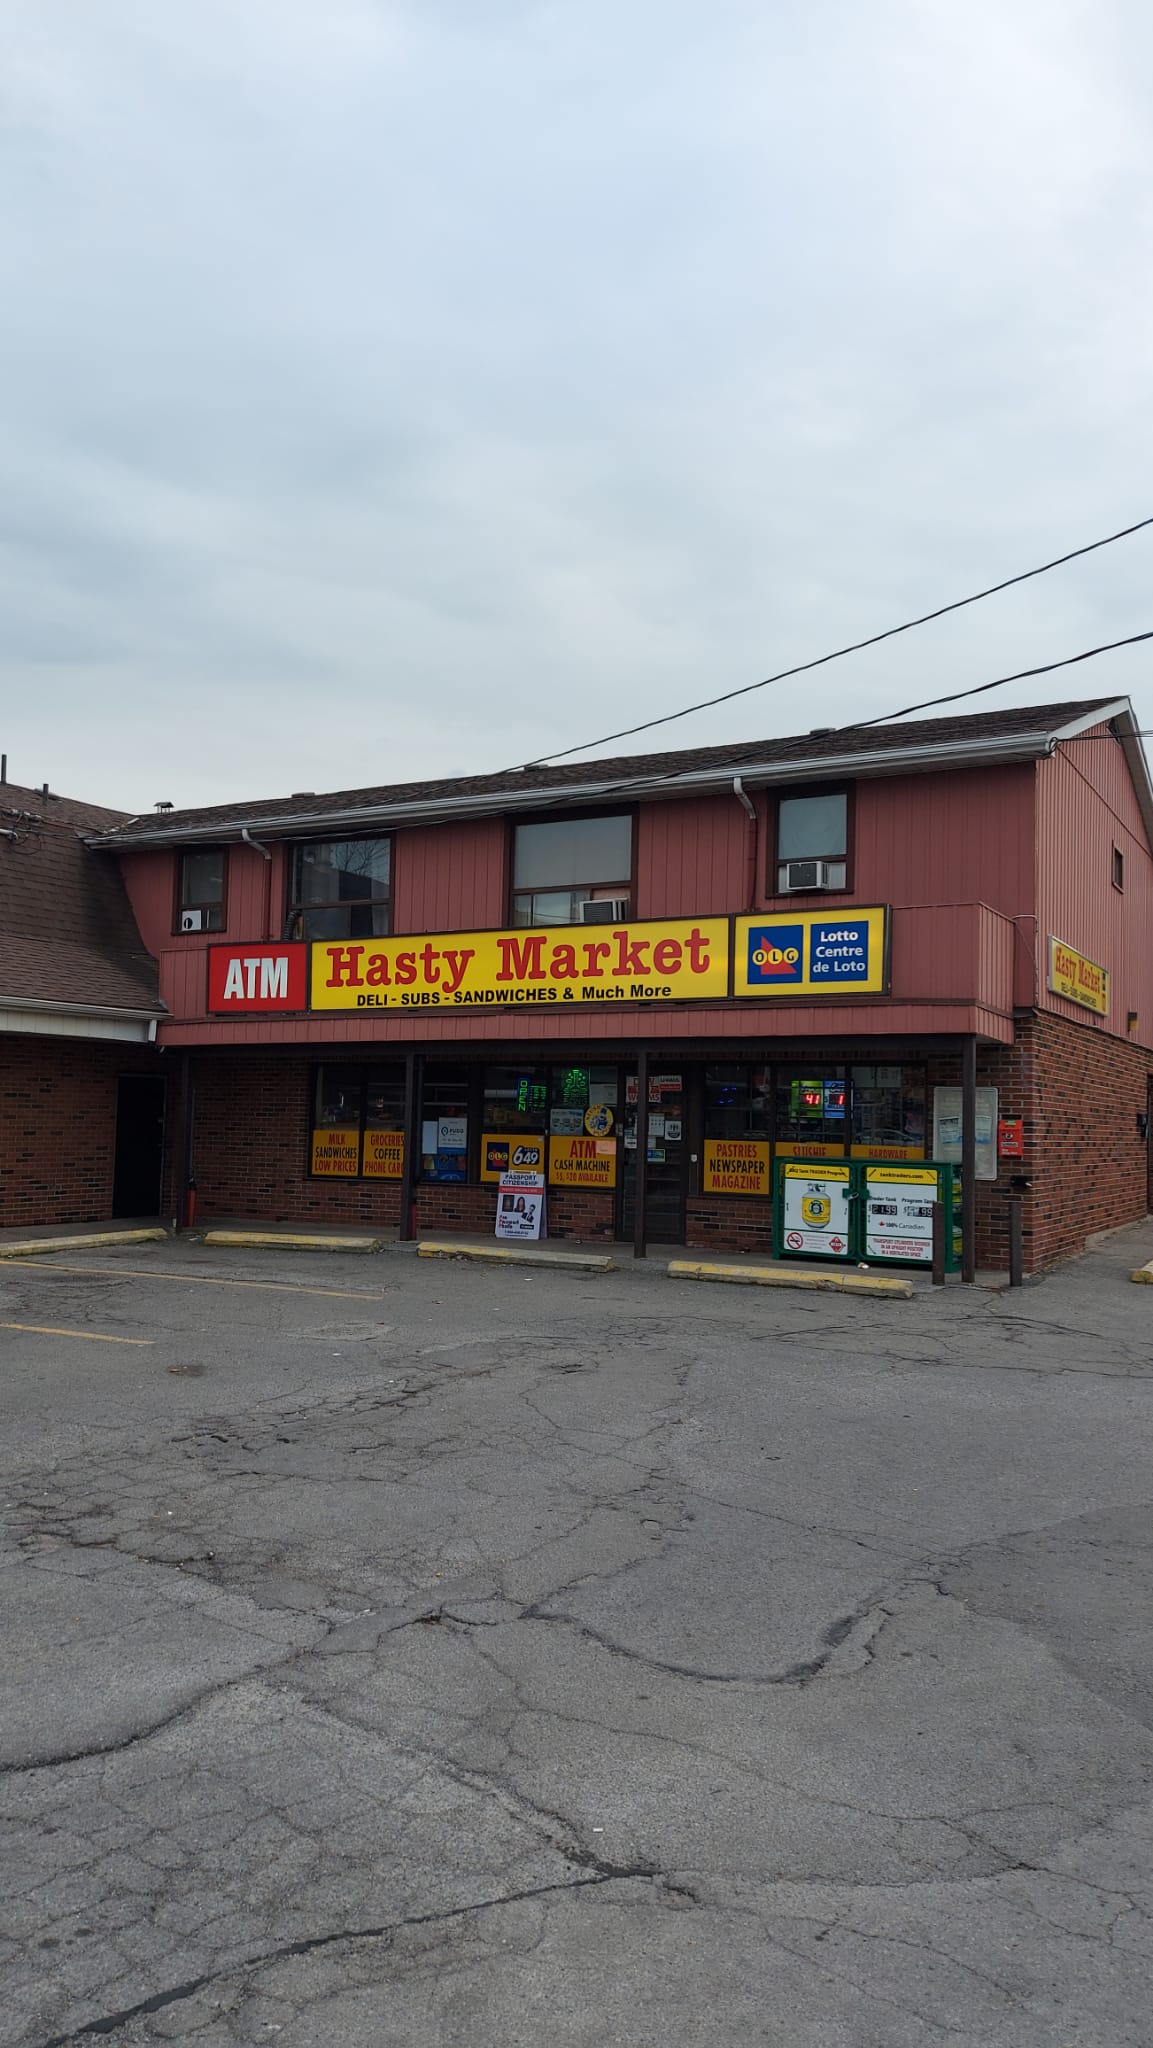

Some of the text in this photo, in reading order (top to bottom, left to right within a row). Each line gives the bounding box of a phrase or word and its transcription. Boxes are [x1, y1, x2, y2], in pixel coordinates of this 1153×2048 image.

[820, 931, 859, 943] Lotto
[753, 948, 798, 965] OLG
[815, 946, 864, 958] Centre
[325, 928, 711, 993] Hasty Market
[812, 960, 866, 973] de Loto
[1056, 946, 1076, 987] Hasty
[1078, 959, 1101, 994] Market
[223, 957, 289, 1000] ATM
[357, 994, 388, 1006] DELI
[401, 992, 440, 1005] SUBS
[453, 987, 557, 1004] SANDWICHES
[562, 987, 575, 1000] &
[582, 985, 625, 1000] Much
[630, 984, 672, 998] More
[518, 1080, 528, 1112] OPEN
[805, 1094, 820, 1105] 41
[328, 1133, 346, 1145] MILK
[315, 1147, 357, 1159] SANDWICHES
[374, 1148, 400, 1160] COFFEE
[569, 1140, 597, 1159] ATM
[716, 1144, 758, 1159] PASTRIES
[488, 1152, 508, 1161] OLG
[314, 1160, 357, 1173] LOW PRICES
[364, 1161, 386, 1173] PHONE
[554, 1160, 610, 1172] CASH MACHINE
[709, 1159, 765, 1175] NEWSPAPER
[578, 1172, 608, 1183] AVAILABLE
[712, 1174, 761, 1190] MAGAZINE
